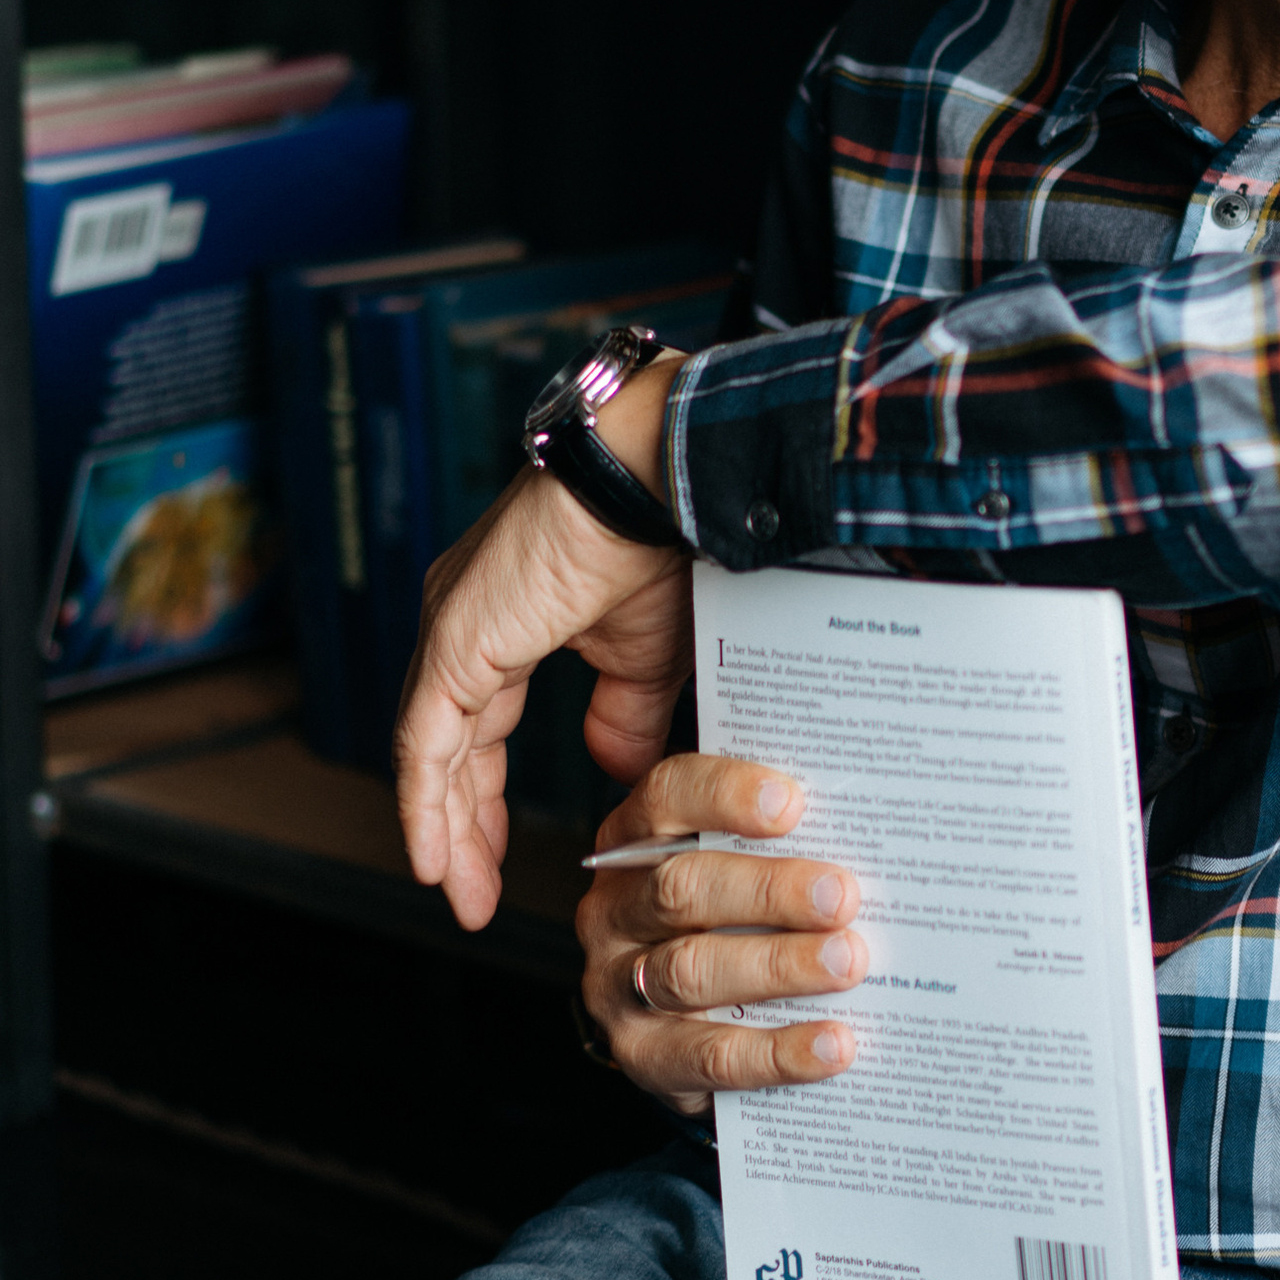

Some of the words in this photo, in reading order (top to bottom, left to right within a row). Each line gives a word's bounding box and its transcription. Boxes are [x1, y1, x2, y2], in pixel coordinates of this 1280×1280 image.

[828, 616, 864, 632] About
[867, 620, 886, 633] the
[889, 621, 922, 636] Book
[733, 644, 746, 655] her
[771, 648, 803, 662] Practical
[726, 660, 770, 673] understands
[766, 679, 798, 693] required
[717, 688, 730, 698] and
[731, 690, 768, 704] guidelines
[729, 704, 743, 715] The
[744, 706, 768, 719] reader
[796, 712, 844, 727] understands
[756, 738, 794, 752] important
[890, 976, 910, 988] the
[914, 978, 957, 994] Author
[784, 1001, 829, 1017] Bharadwaj
[782, 1088, 797, 1098] the
[801, 1091, 846, 1107] prestigious
[739, 1096, 789, 1111] Educational
[789, 1102, 838, 1117] Foundation
[874, 1112, 894, 1123] State
[740, 1110, 774, 1124] Pradesh
[792, 1118, 827, 1130] awarded
[756, 1126, 777, 1138] Gold
[779, 1130, 805, 1142] medal
[824, 1136, 859, 1149] awarded
[902, 1143, 939, 1159] standing
[955, 1151, 978, 1163] India
[743, 1139, 768, 1151] ICAS.
[773, 1143, 788, 1154] She
[813, 1149, 848, 1161] awarded
[939, 1163, 972, 1177] Vidwan
[744, 1154, 793, 1169] Hyderabad.
[797, 1160, 825, 1174] Jyotish
[829, 1164, 868, 1178] Saraswati
[746, 1168, 781, 1182] Lifetime
[782, 1171, 836, 1188] Achievement
[838, 1180, 865, 1192] Award
[877, 1184, 900, 1197] ICAS
[925, 1190, 949, 1203] Silver
[950, 1193, 978, 1207] Jubilee
[1009, 1202, 1032, 1214] ICAS
[815, 1252, 864, 1267] Saptarishis
[866, 1259, 921, 1273] Publications
[815, 1265, 842, 1277] C-2/18
